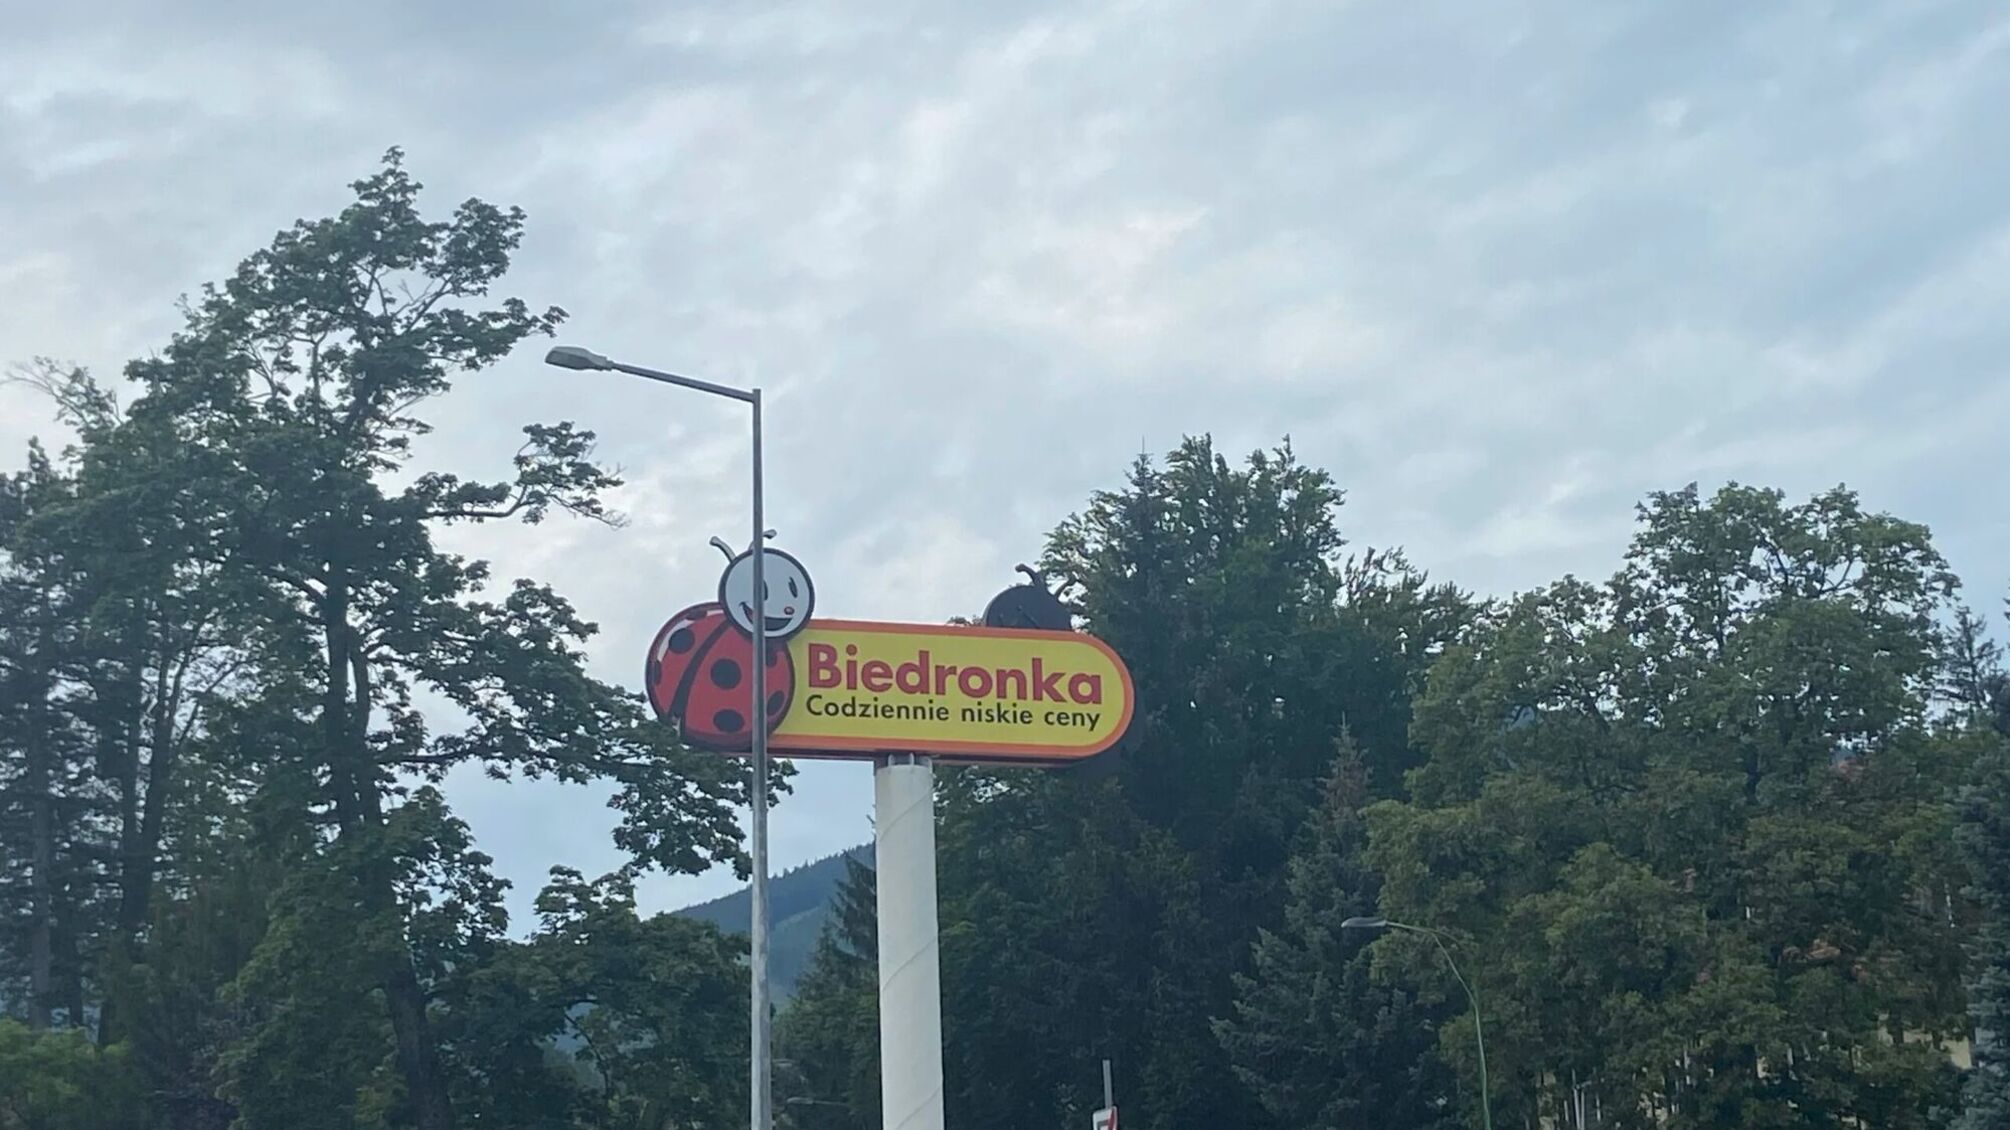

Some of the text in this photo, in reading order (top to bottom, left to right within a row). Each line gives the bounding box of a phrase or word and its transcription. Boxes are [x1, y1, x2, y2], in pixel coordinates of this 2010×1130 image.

[808, 643, 1102, 705] Biedronka
[806, 695, 1101, 732] Codziennie niskie ceny
